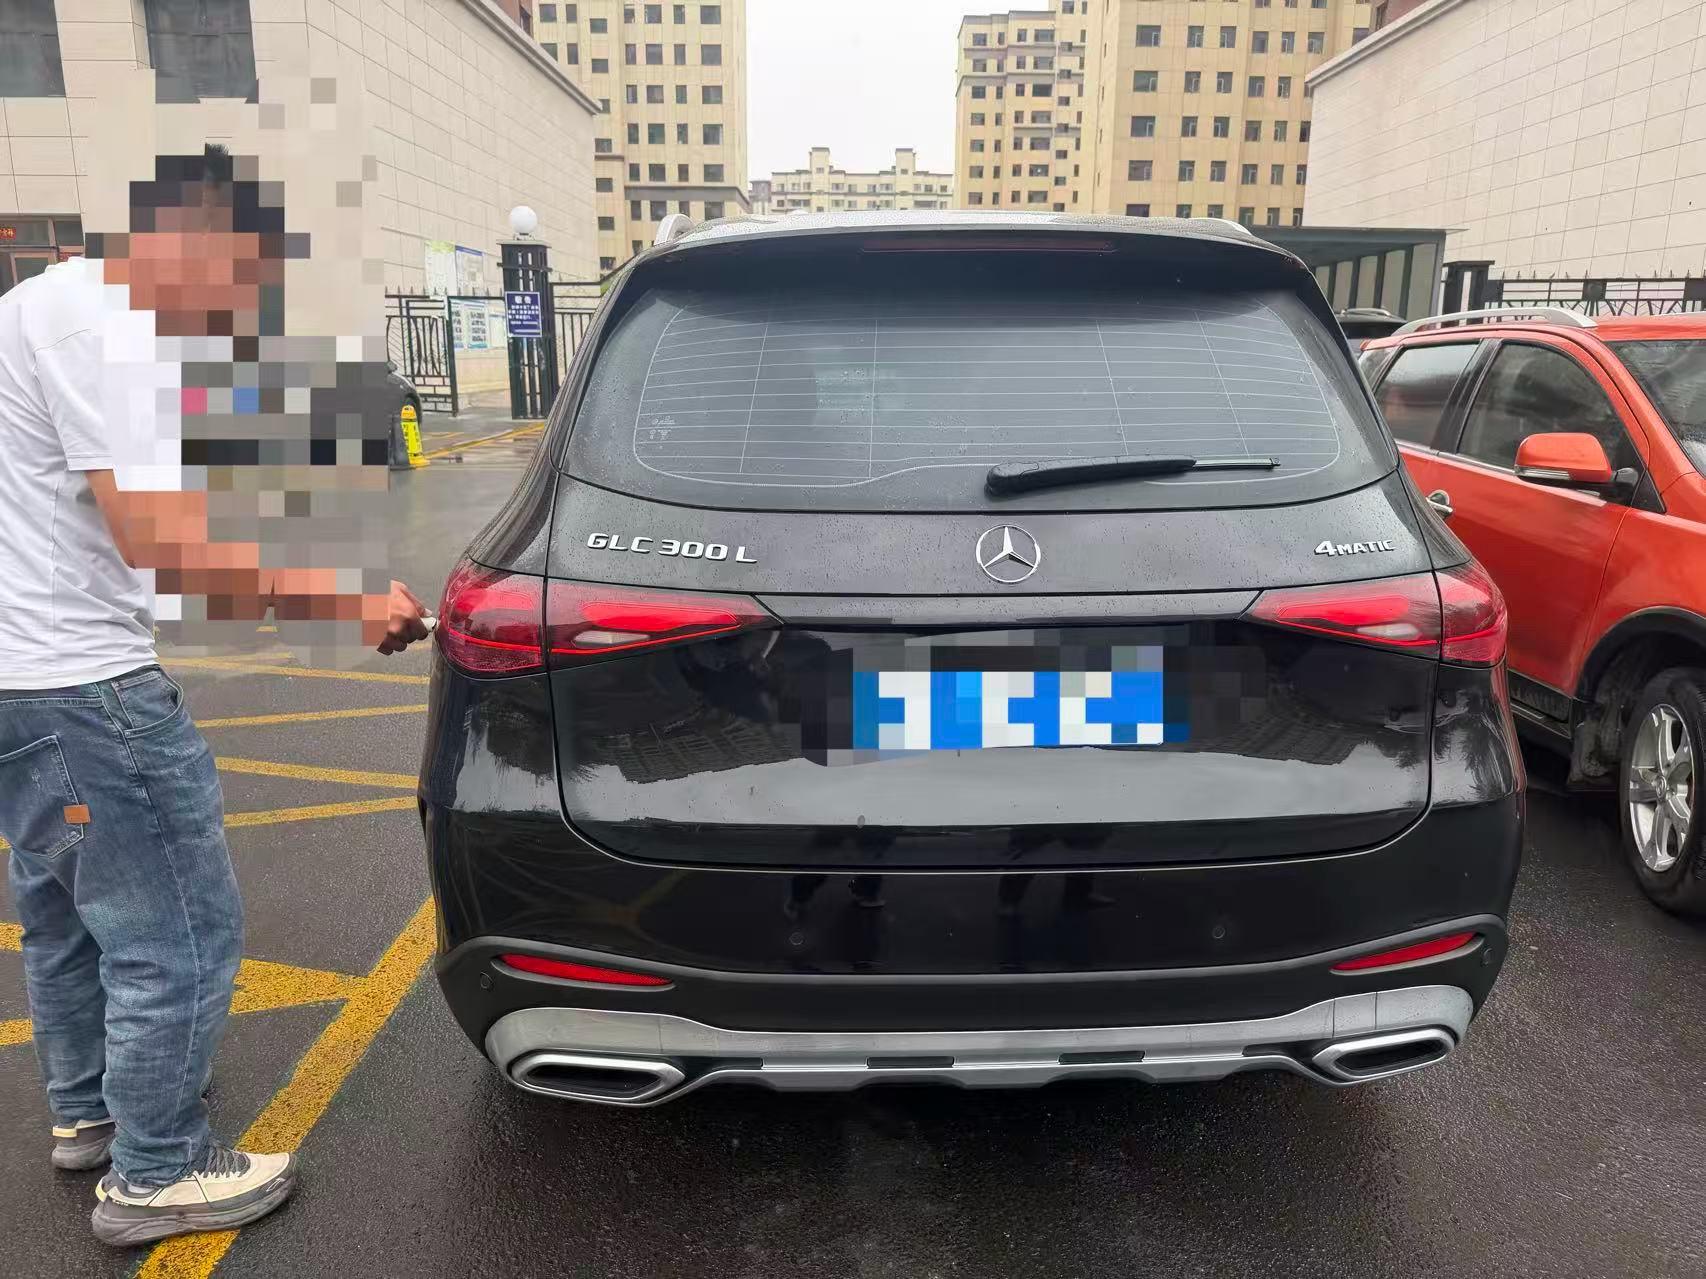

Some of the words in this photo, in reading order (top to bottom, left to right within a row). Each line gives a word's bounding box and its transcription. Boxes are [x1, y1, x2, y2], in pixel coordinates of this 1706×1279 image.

[587, 532, 653, 553] GLC
[658, 539, 728, 561] 300
[735, 546, 757, 563] L
[1314, 540, 1396, 556] 4MATIC
